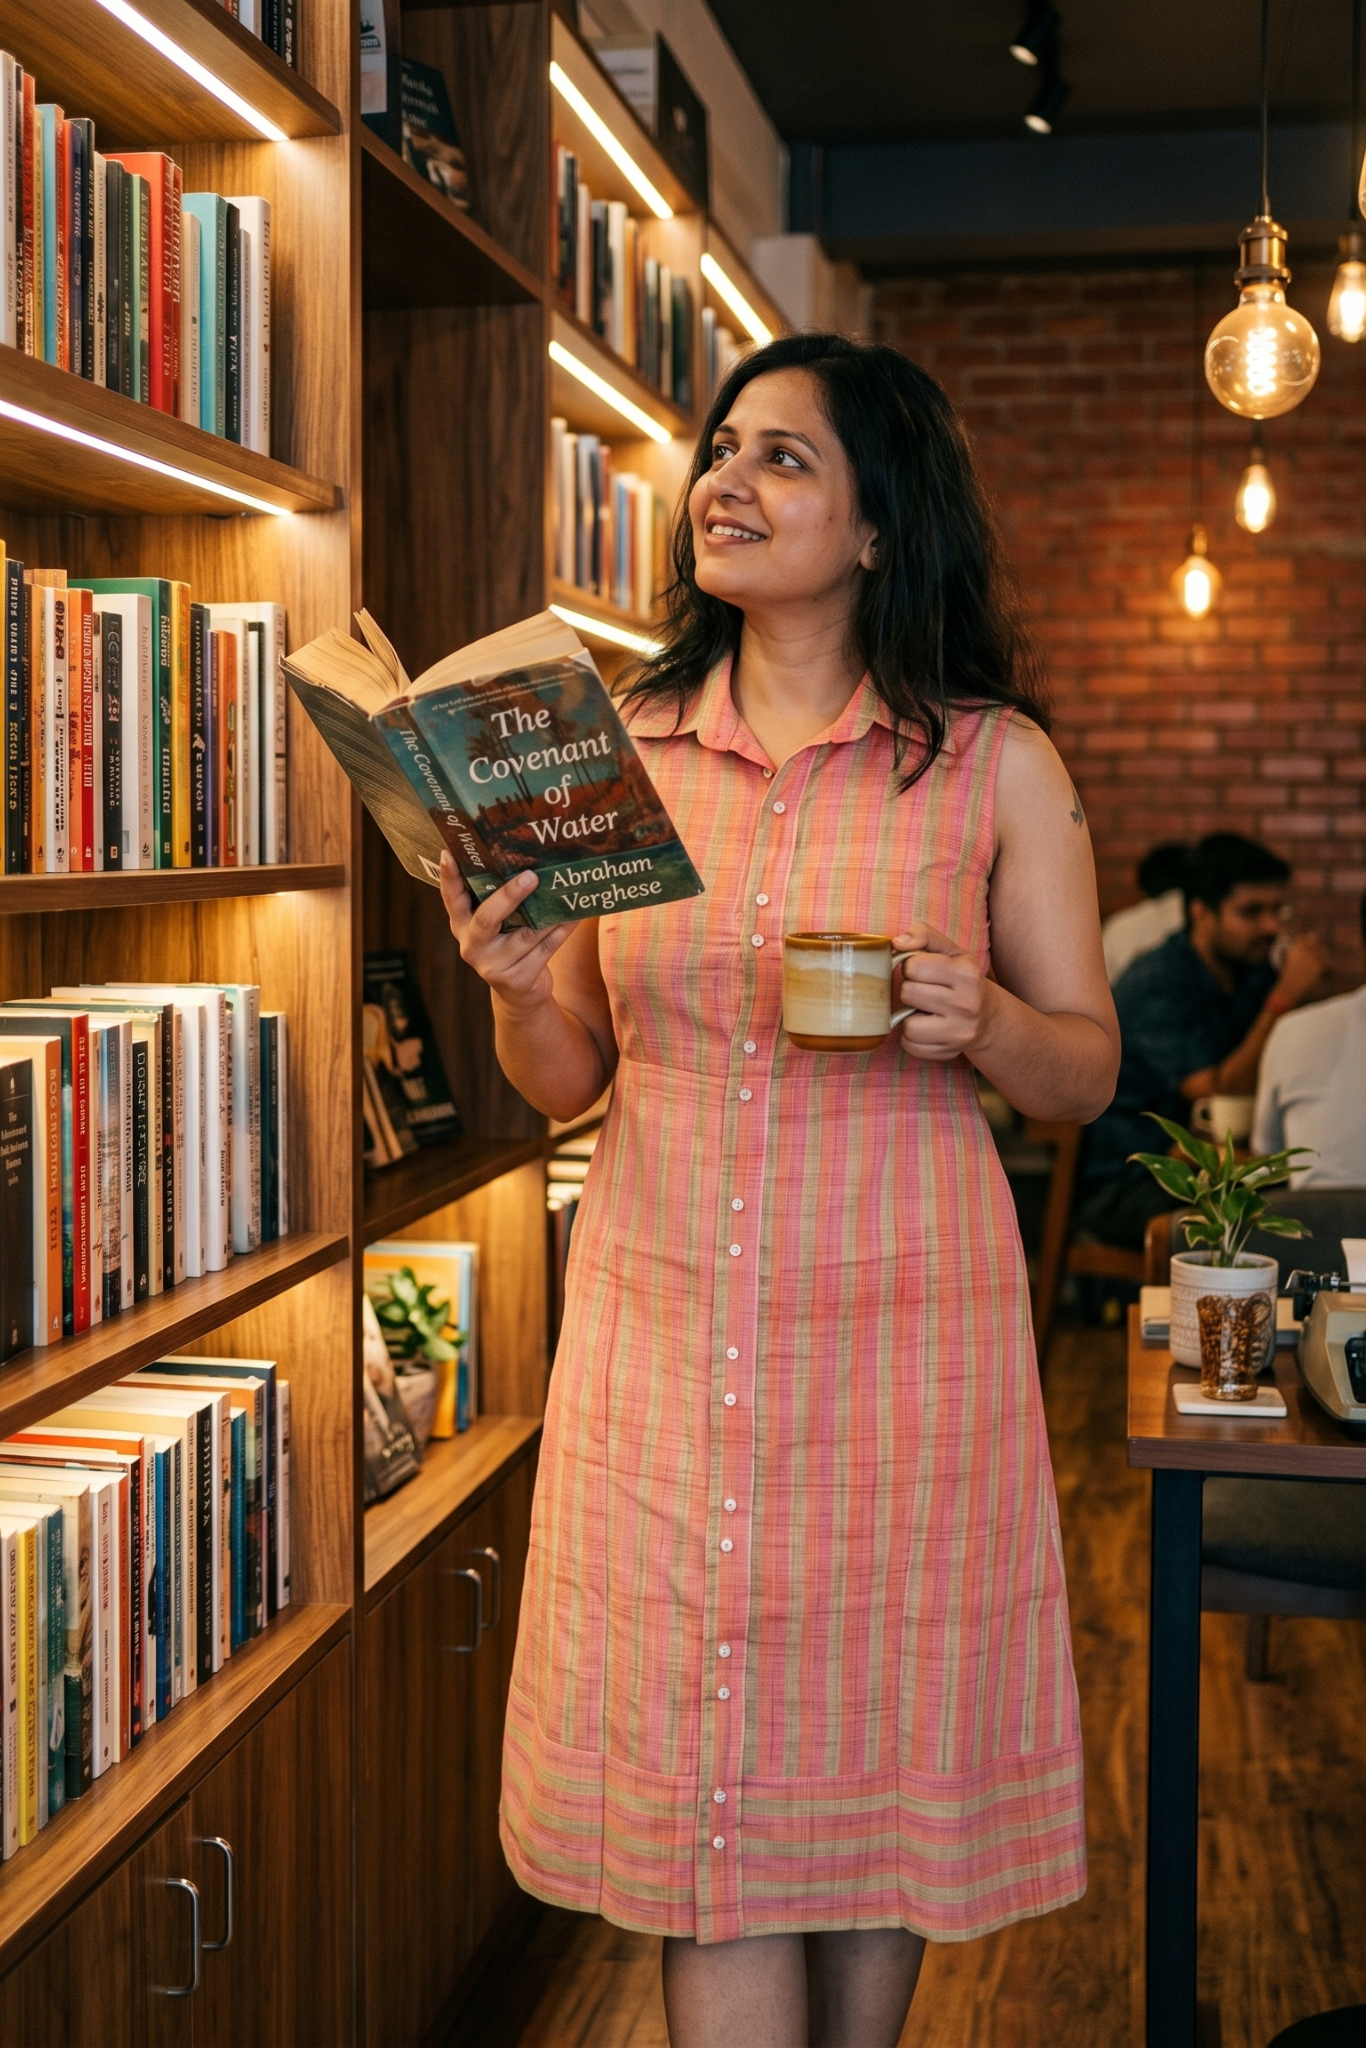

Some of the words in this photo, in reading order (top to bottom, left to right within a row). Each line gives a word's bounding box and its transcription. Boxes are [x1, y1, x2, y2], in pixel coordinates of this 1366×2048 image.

[490, 706, 552, 739] The
[469, 731, 612, 784] Covenant
[399, 726, 419, 751] The
[446, 814, 466, 830] of
[458, 832, 486, 869] Water
[544, 774, 572, 808] of
[527, 811, 619, 845] Water
[550, 858, 654, 890] Abraham
[561, 880, 663, 911] Verghese
